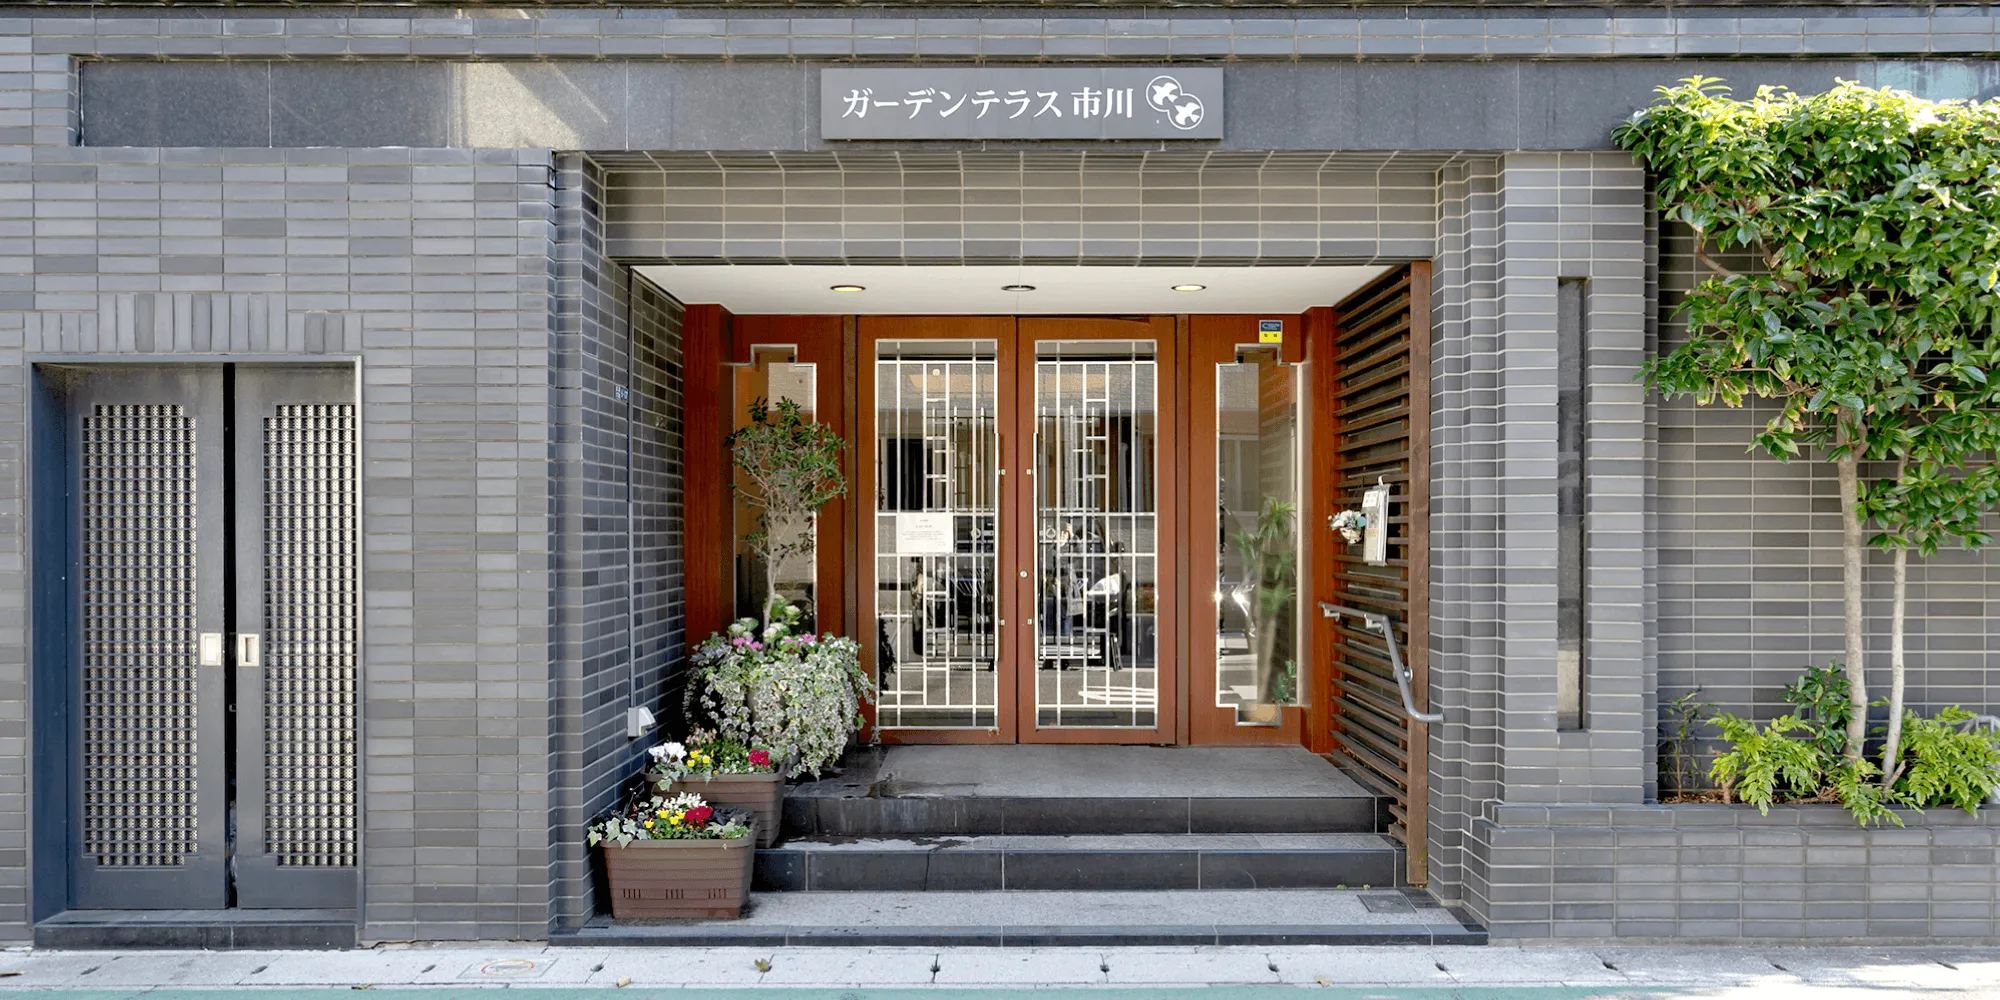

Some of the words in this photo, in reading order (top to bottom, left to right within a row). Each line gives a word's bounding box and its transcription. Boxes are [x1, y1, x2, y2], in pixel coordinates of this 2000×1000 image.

[841, 87, 1063, 119] ガーデンテラス
[1070, 86, 1134, 119] 市川
